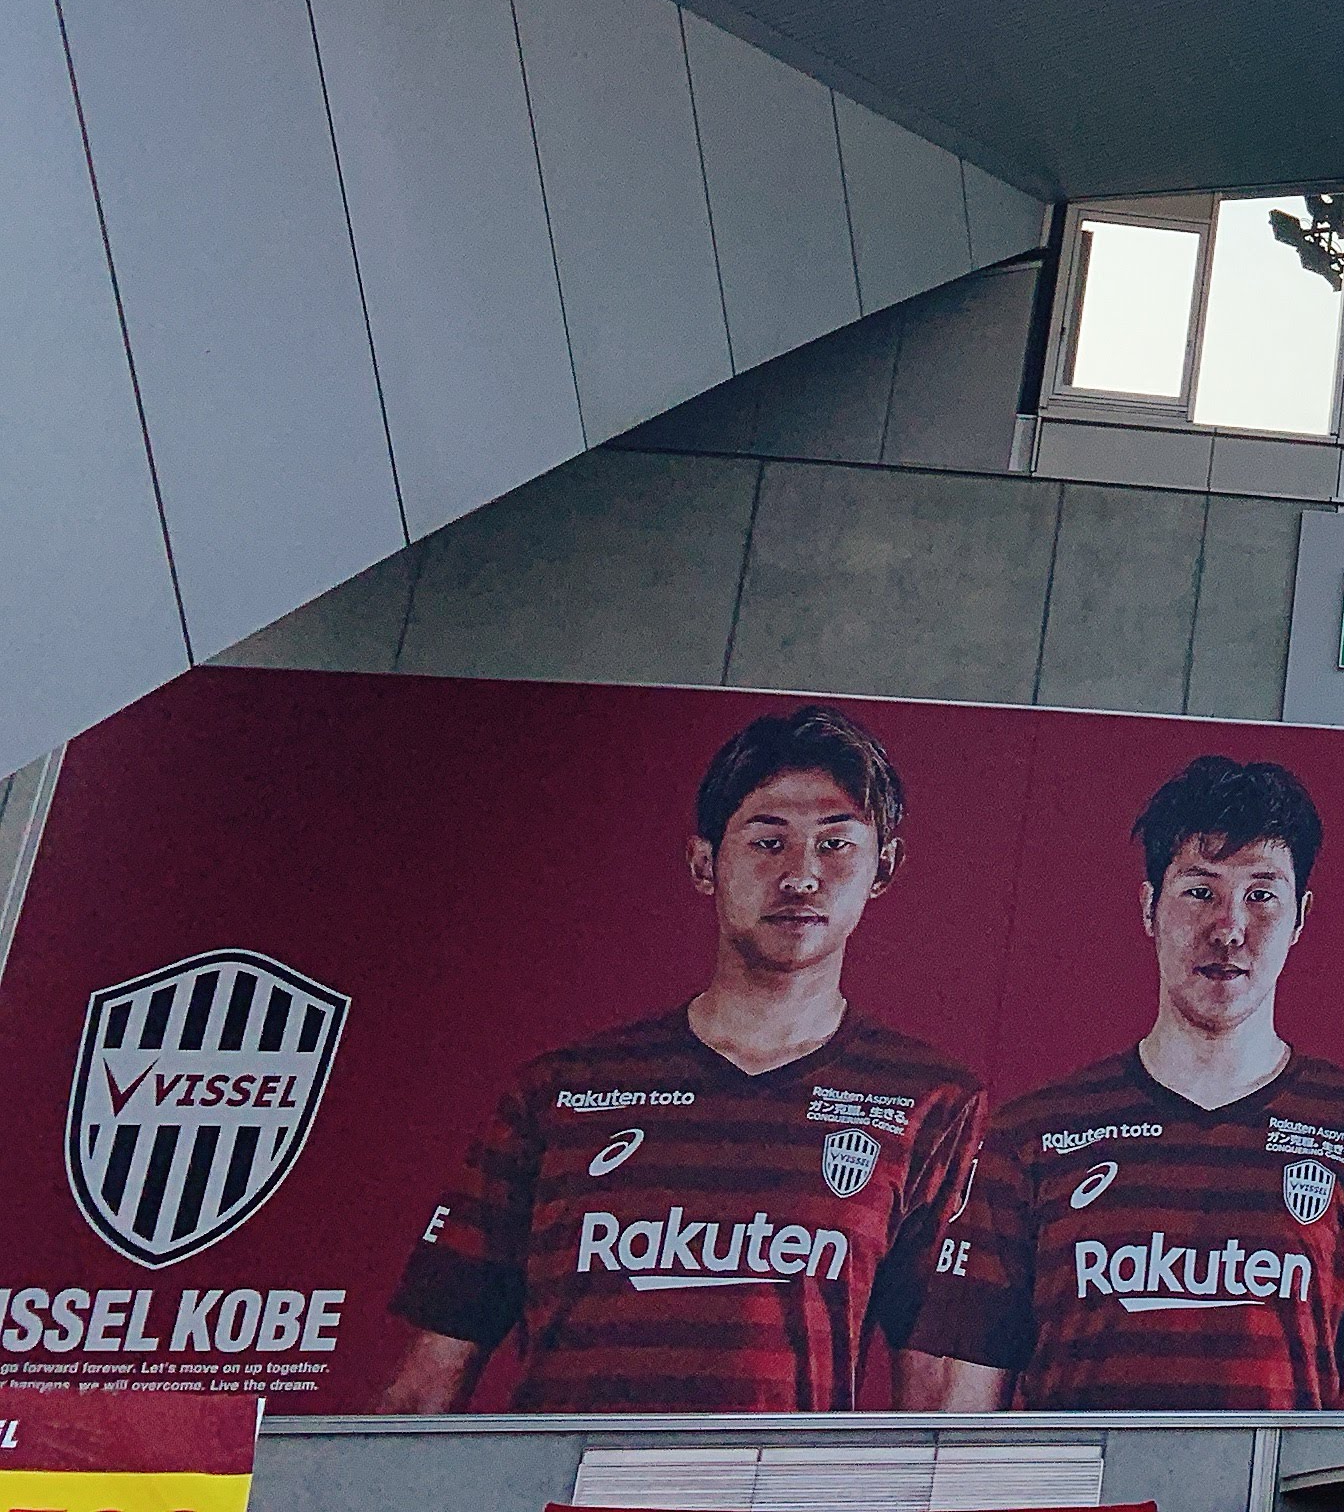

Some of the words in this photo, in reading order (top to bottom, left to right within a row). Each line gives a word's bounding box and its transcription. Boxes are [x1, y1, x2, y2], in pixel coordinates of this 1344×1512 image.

[155, 1073, 298, 1108] VISSEL
[556, 1088, 647, 1108] Rakuten
[649, 1089, 695, 1106] toto
[812, 1086, 864, 1101] Rakuten
[1042, 1123, 1117, 1152] Rakuten
[1120, 1122, 1163, 1139] toto
[1269, 1117, 1316, 1135] Rakuten
[577, 1206, 848, 1280] Rakuten
[1075, 1231, 1312, 1302] Rakuten
[169, 1287, 347, 1353] KOBE
[23, 1361, 78, 1374] forward
[82, 1362, 136, 1374] forever.
[141, 1361, 176, 1374] Let's
[179, 1364, 219, 1374] move
[222, 1364, 241, 1373] on
[244, 1364, 262, 1375] up
[266, 1362, 330, 1376] together.
[131, 1380, 205, 1392] overcome.
[210, 1379, 239, 1391] Live
[243, 1379, 266, 1391] the
[269, 1379, 319, 1391] dream.
